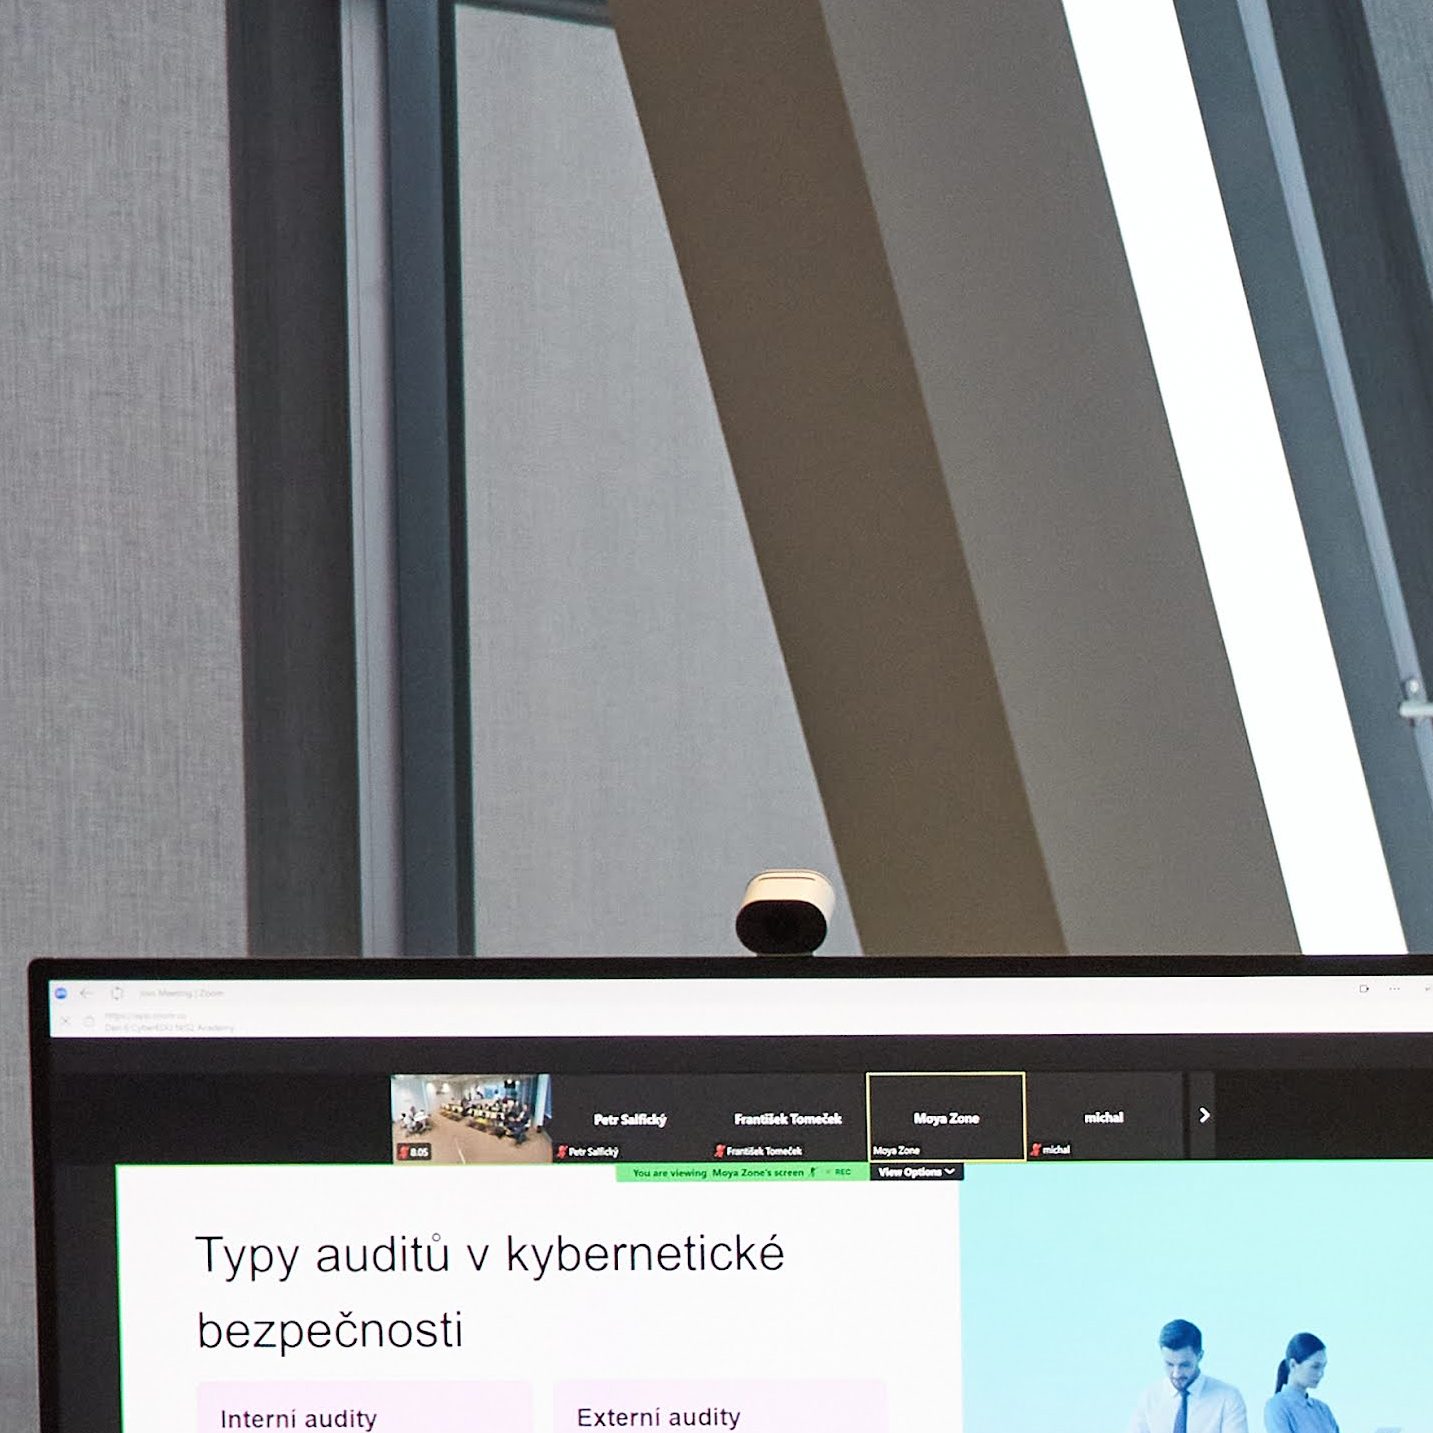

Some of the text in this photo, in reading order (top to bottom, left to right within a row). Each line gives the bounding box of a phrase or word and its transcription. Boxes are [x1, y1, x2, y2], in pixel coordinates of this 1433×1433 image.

[594, 1113, 667, 1128] Petr Salfický
[735, 1113, 842, 1125] František Tomeček
[914, 1113, 980, 1126] Moya Zone
[1085, 1112, 1124, 1123] michal
[569, 1148, 586, 1156] Petr
[873, 1146, 920, 1157] Moya Zone
[1043, 1145, 1070, 1154] michal
[634, 1169, 650, 1177] You
[671, 1169, 706, 1179] viewing
[713, 1169, 738, 1178] Moya
[879, 1167, 942, 1178] View Options
[195, 1233, 783, 1282] Typy auditů v kybernetické
[200, 1311, 461, 1357] bezpečnosti
[221, 1409, 377, 1433] Interní audity
[578, 1407, 741, 1431] Externí audity
